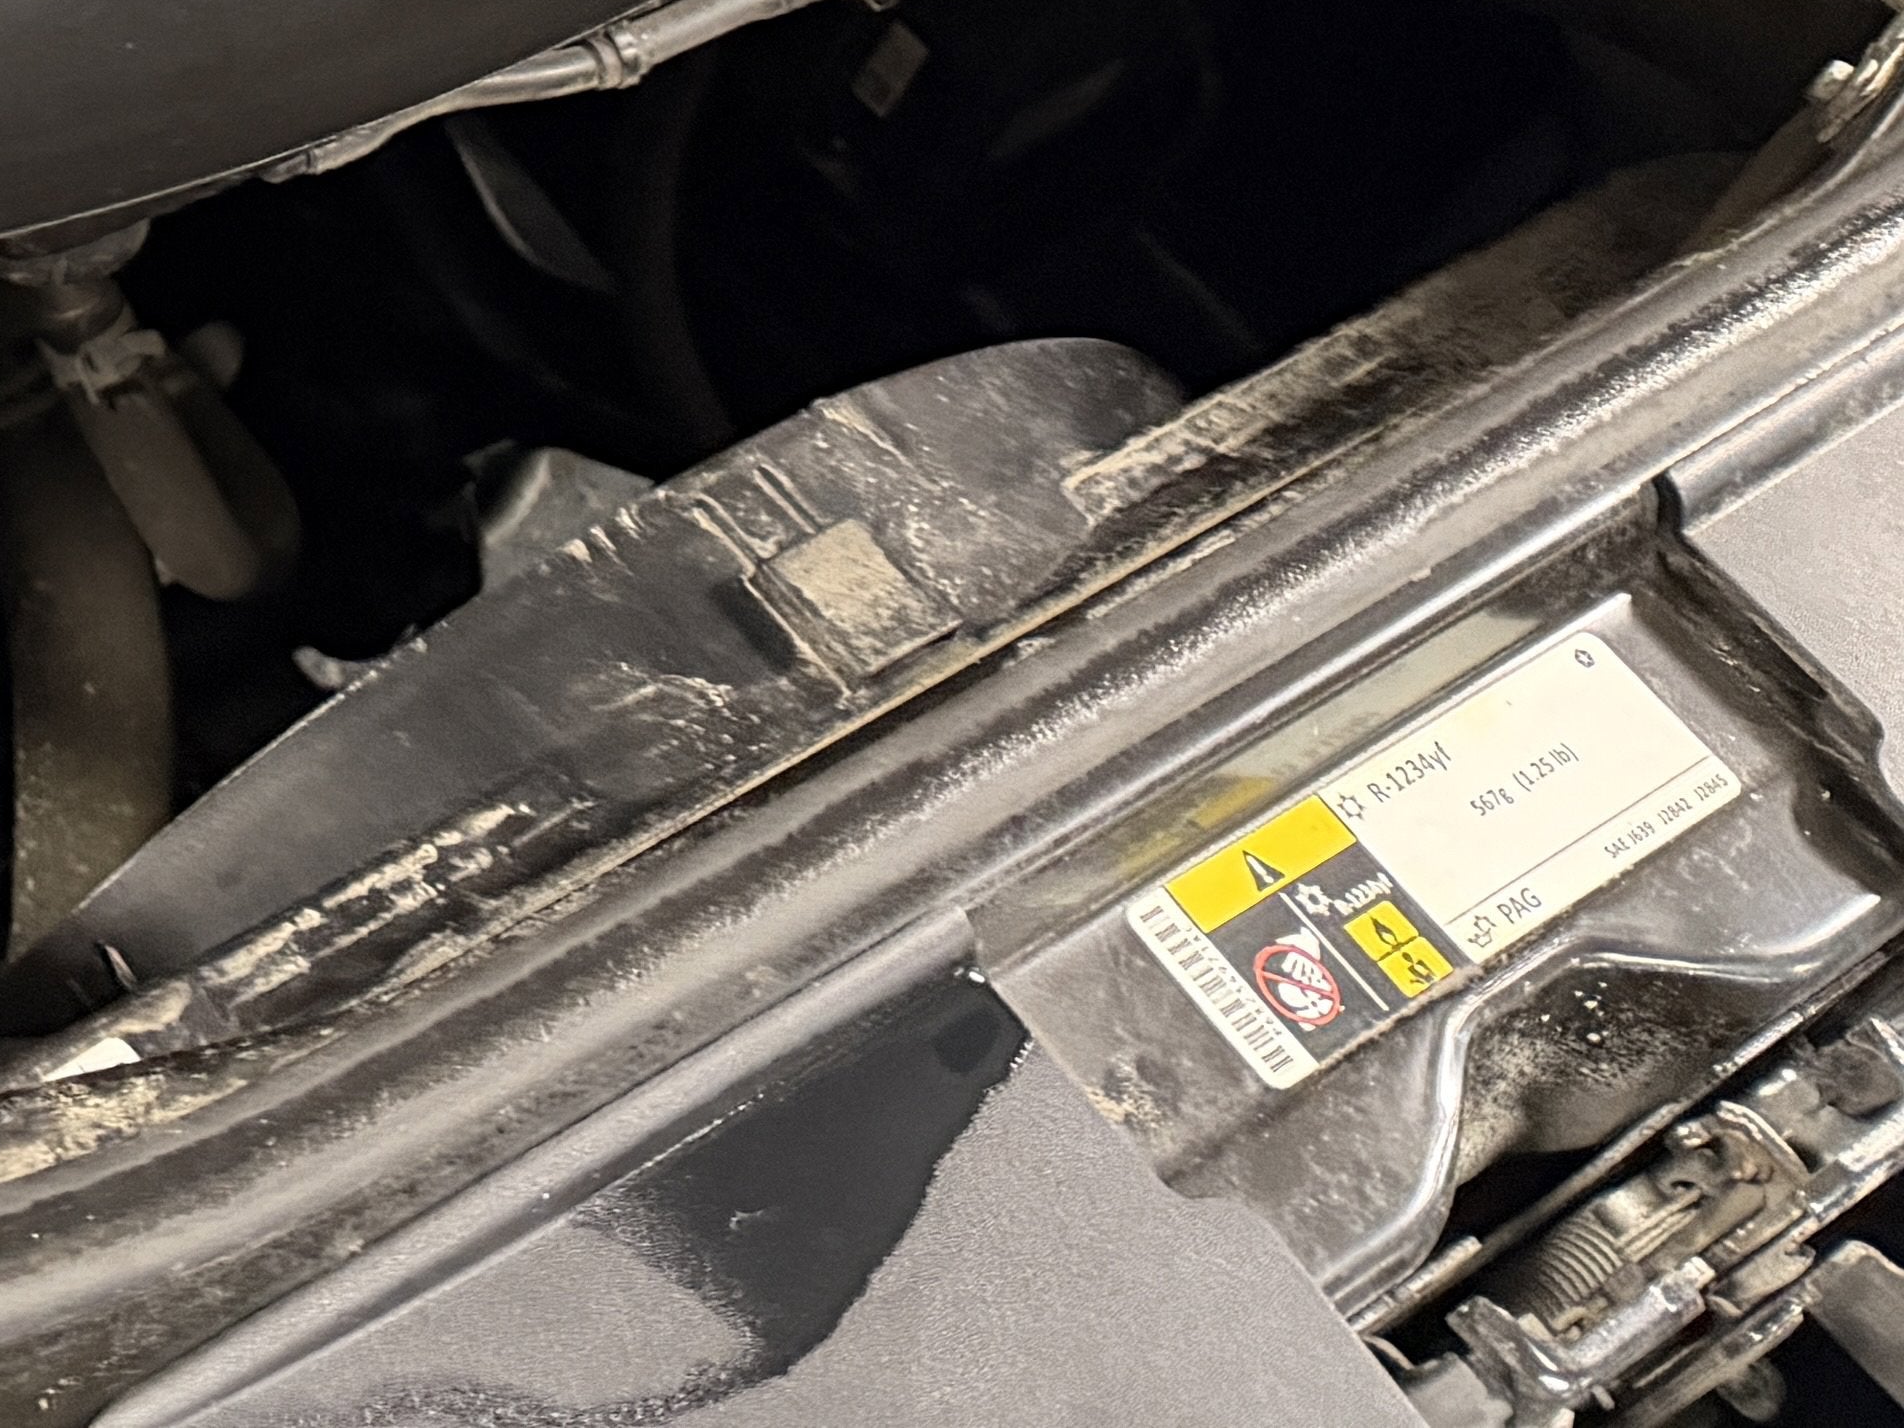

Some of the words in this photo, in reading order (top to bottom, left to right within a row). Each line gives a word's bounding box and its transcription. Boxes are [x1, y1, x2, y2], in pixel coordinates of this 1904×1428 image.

[1366, 741, 1452, 804] R-1234yf
[1469, 786, 1515, 817] 567g
[1512, 755, 1554, 794] (1.25
[1550, 742, 1580, 772] lb)
[1604, 837, 1631, 860] SAE
[1496, 887, 1543, 925] PAG
